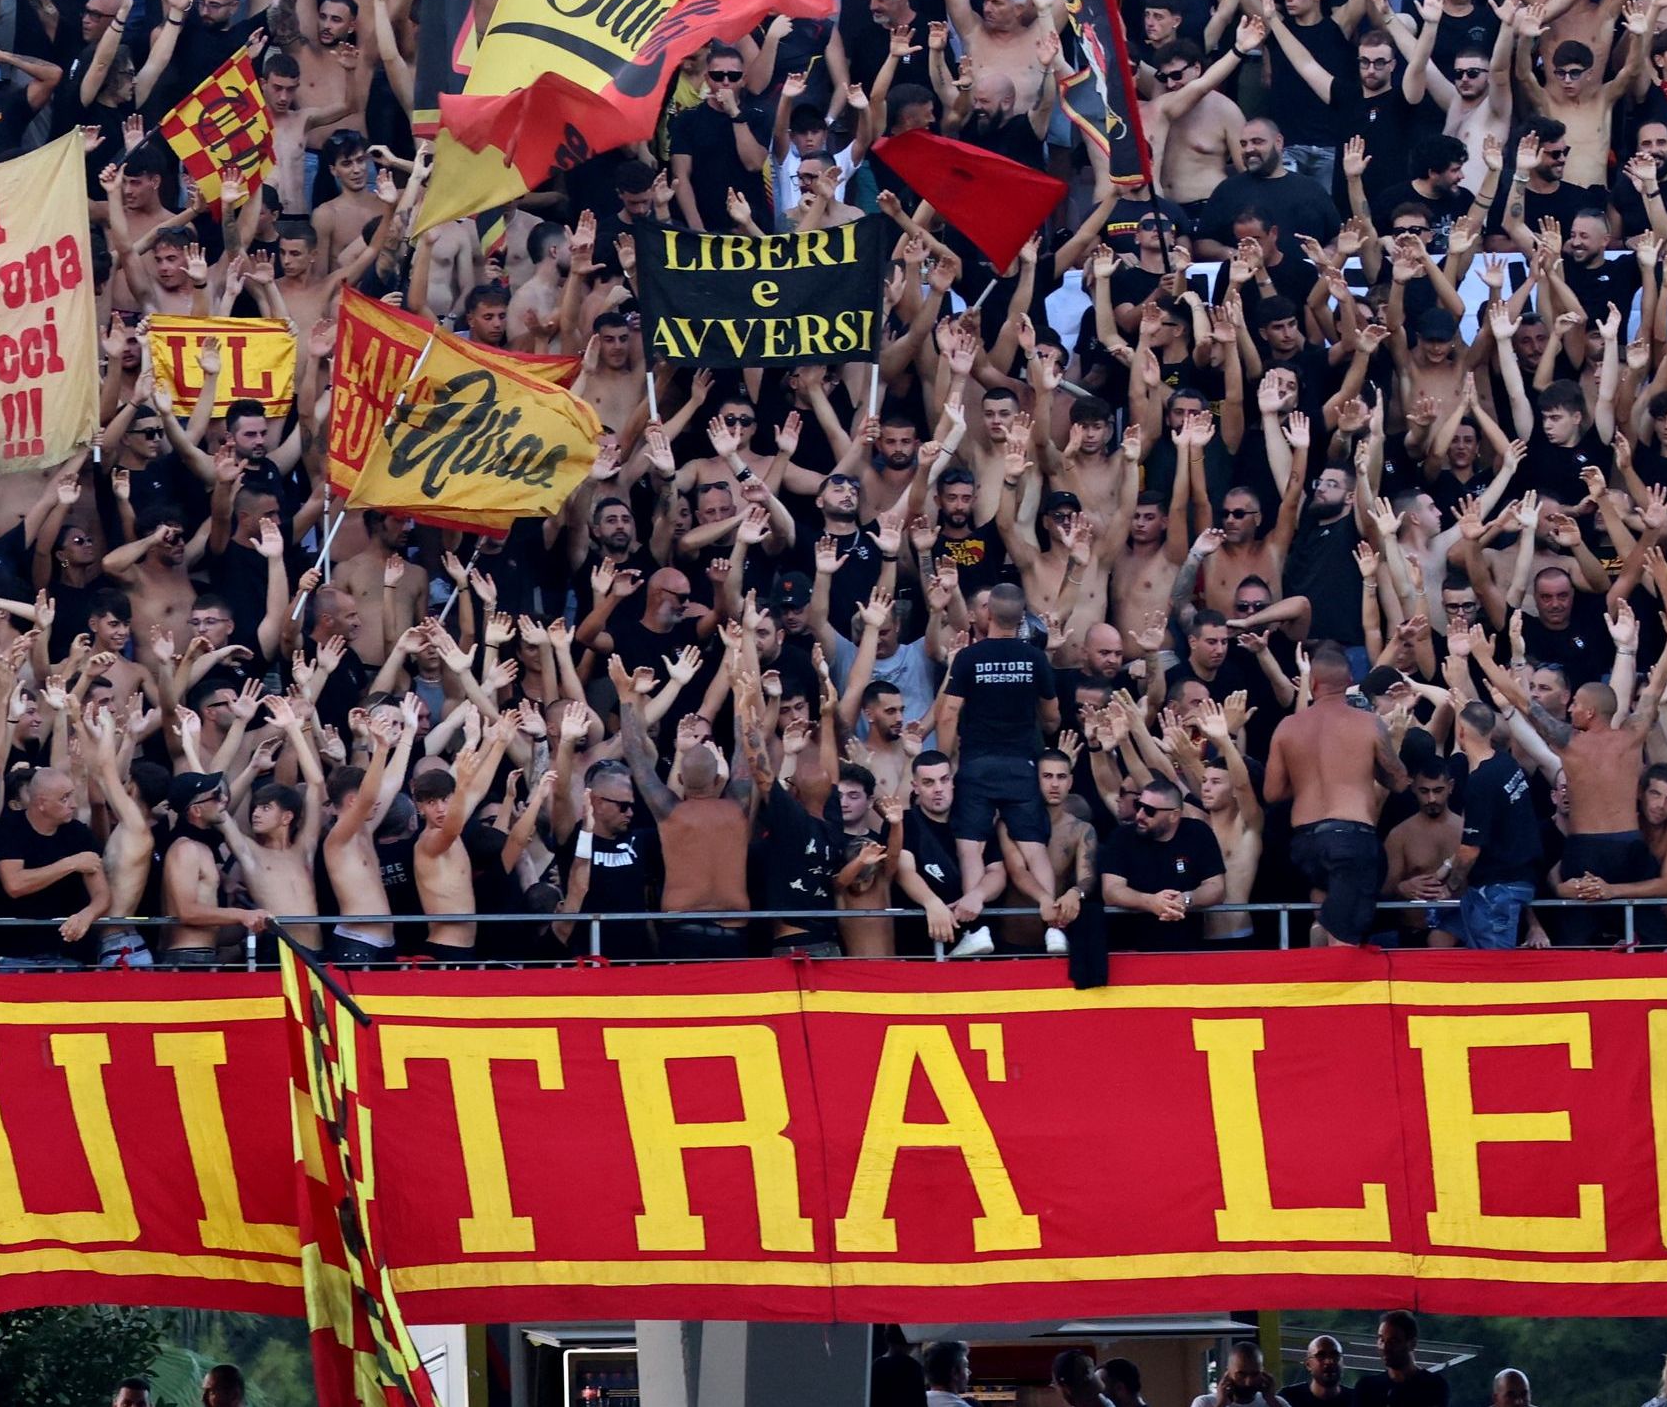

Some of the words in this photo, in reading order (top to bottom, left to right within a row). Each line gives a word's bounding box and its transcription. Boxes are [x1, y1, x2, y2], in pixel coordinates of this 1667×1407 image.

[663, 224, 860, 272] LIBERI
[752, 279, 779, 308] e
[652, 310, 873, 361] AVVERSI
[975, 662, 1033, 674] DOTTORE
[975, 673, 1033, 684] PRESENTE
